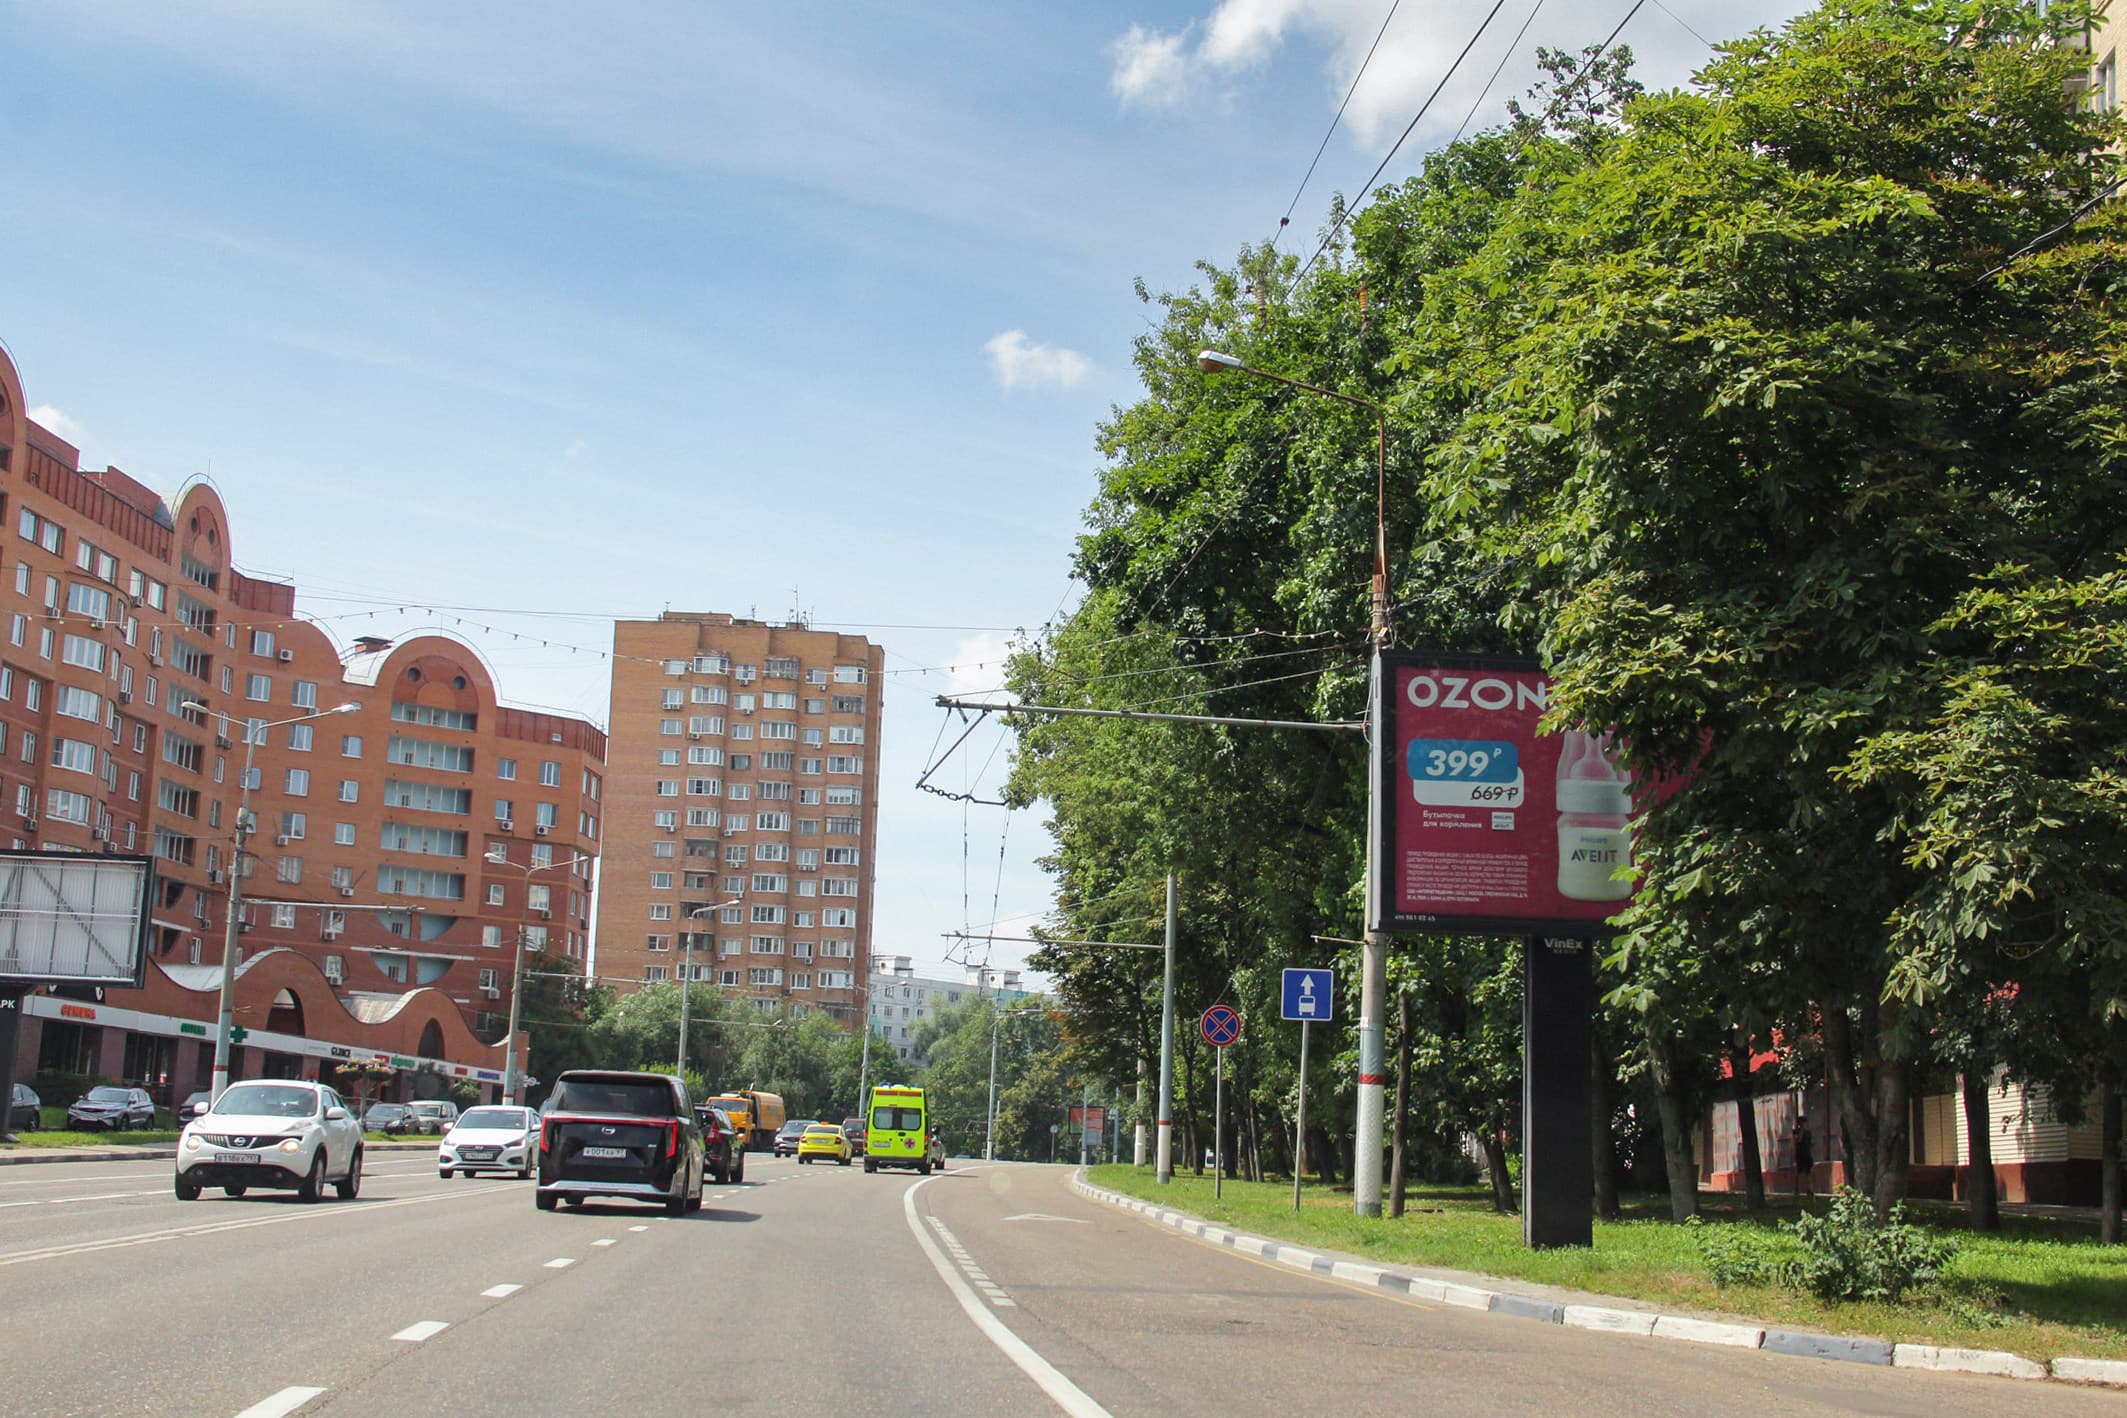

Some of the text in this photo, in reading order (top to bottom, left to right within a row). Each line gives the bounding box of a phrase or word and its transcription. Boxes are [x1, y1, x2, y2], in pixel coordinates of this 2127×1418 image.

[1407, 675, 1547, 712] OZON
[1543, 937, 1585, 950] VinEx
[0, 1000, 15, 1009] РК
